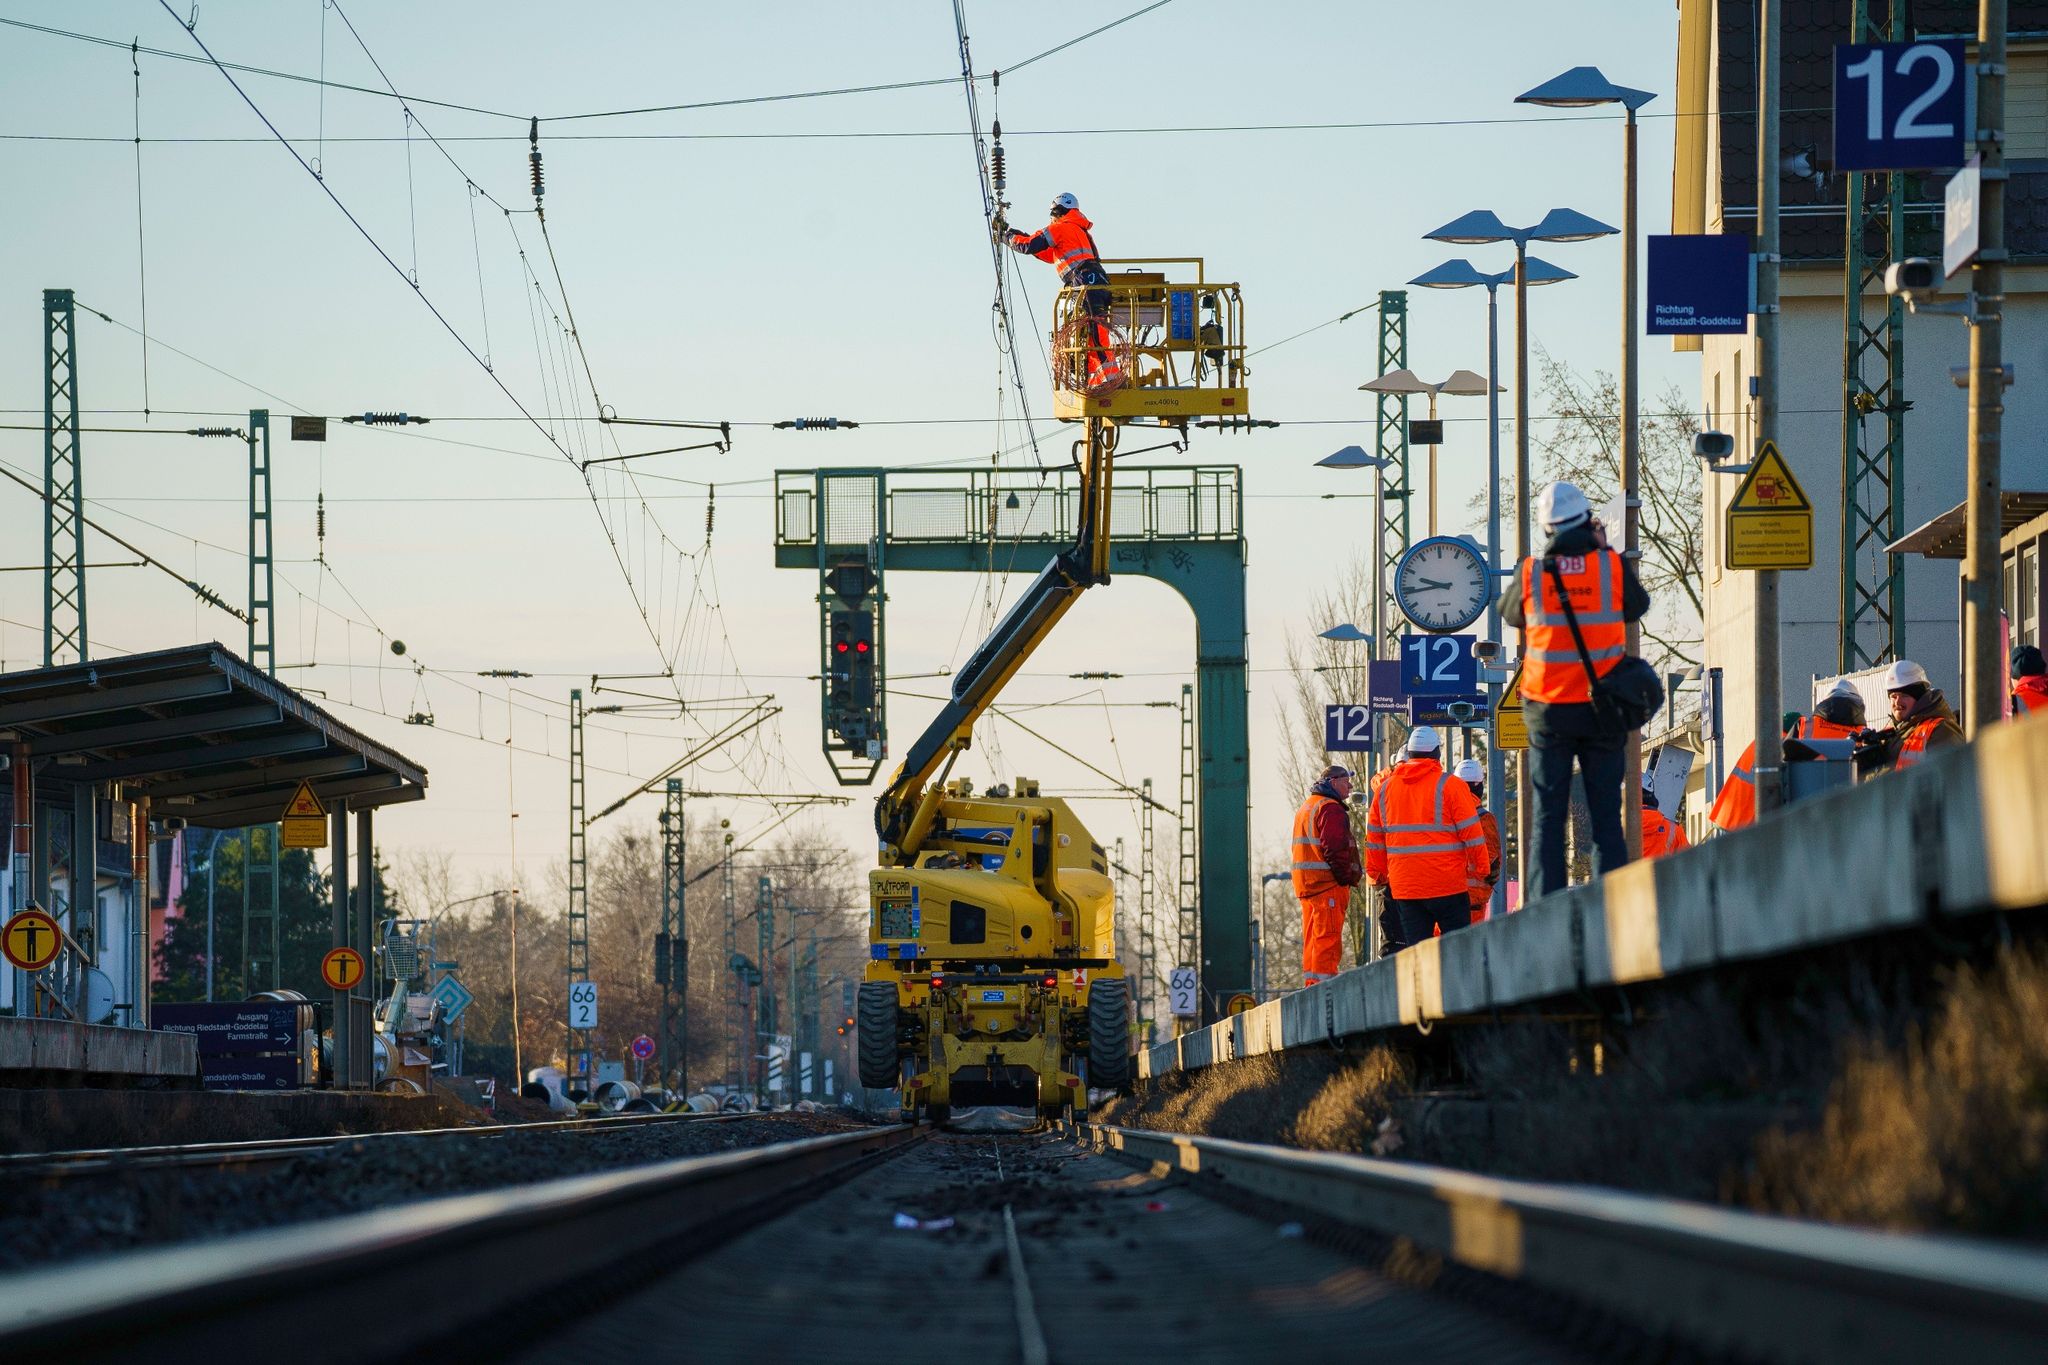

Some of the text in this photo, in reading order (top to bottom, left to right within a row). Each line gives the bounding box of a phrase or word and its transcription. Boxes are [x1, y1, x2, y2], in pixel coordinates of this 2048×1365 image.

[1846, 44, 1954, 140] 12
[1656, 305, 1694, 315] Richtung
[1656, 317, 1741, 326] Riedstadt-Goddelau
[1409, 637, 1460, 681] 12
[1330, 706, 1370, 741] 12
[1171, 972, 1195, 990] 66
[572, 985, 595, 1003] 66
[1178, 991, 1189, 1009] 2
[237, 1013, 269, 1022] Ausgang
[579, 1005, 589, 1022] 2
[163, 1023, 269, 1033] Richtung Riedstadt-Goddelau
[227, 1032, 269, 1040] Farmstraße
[203, 1072, 266, 1081] randström-Straße
